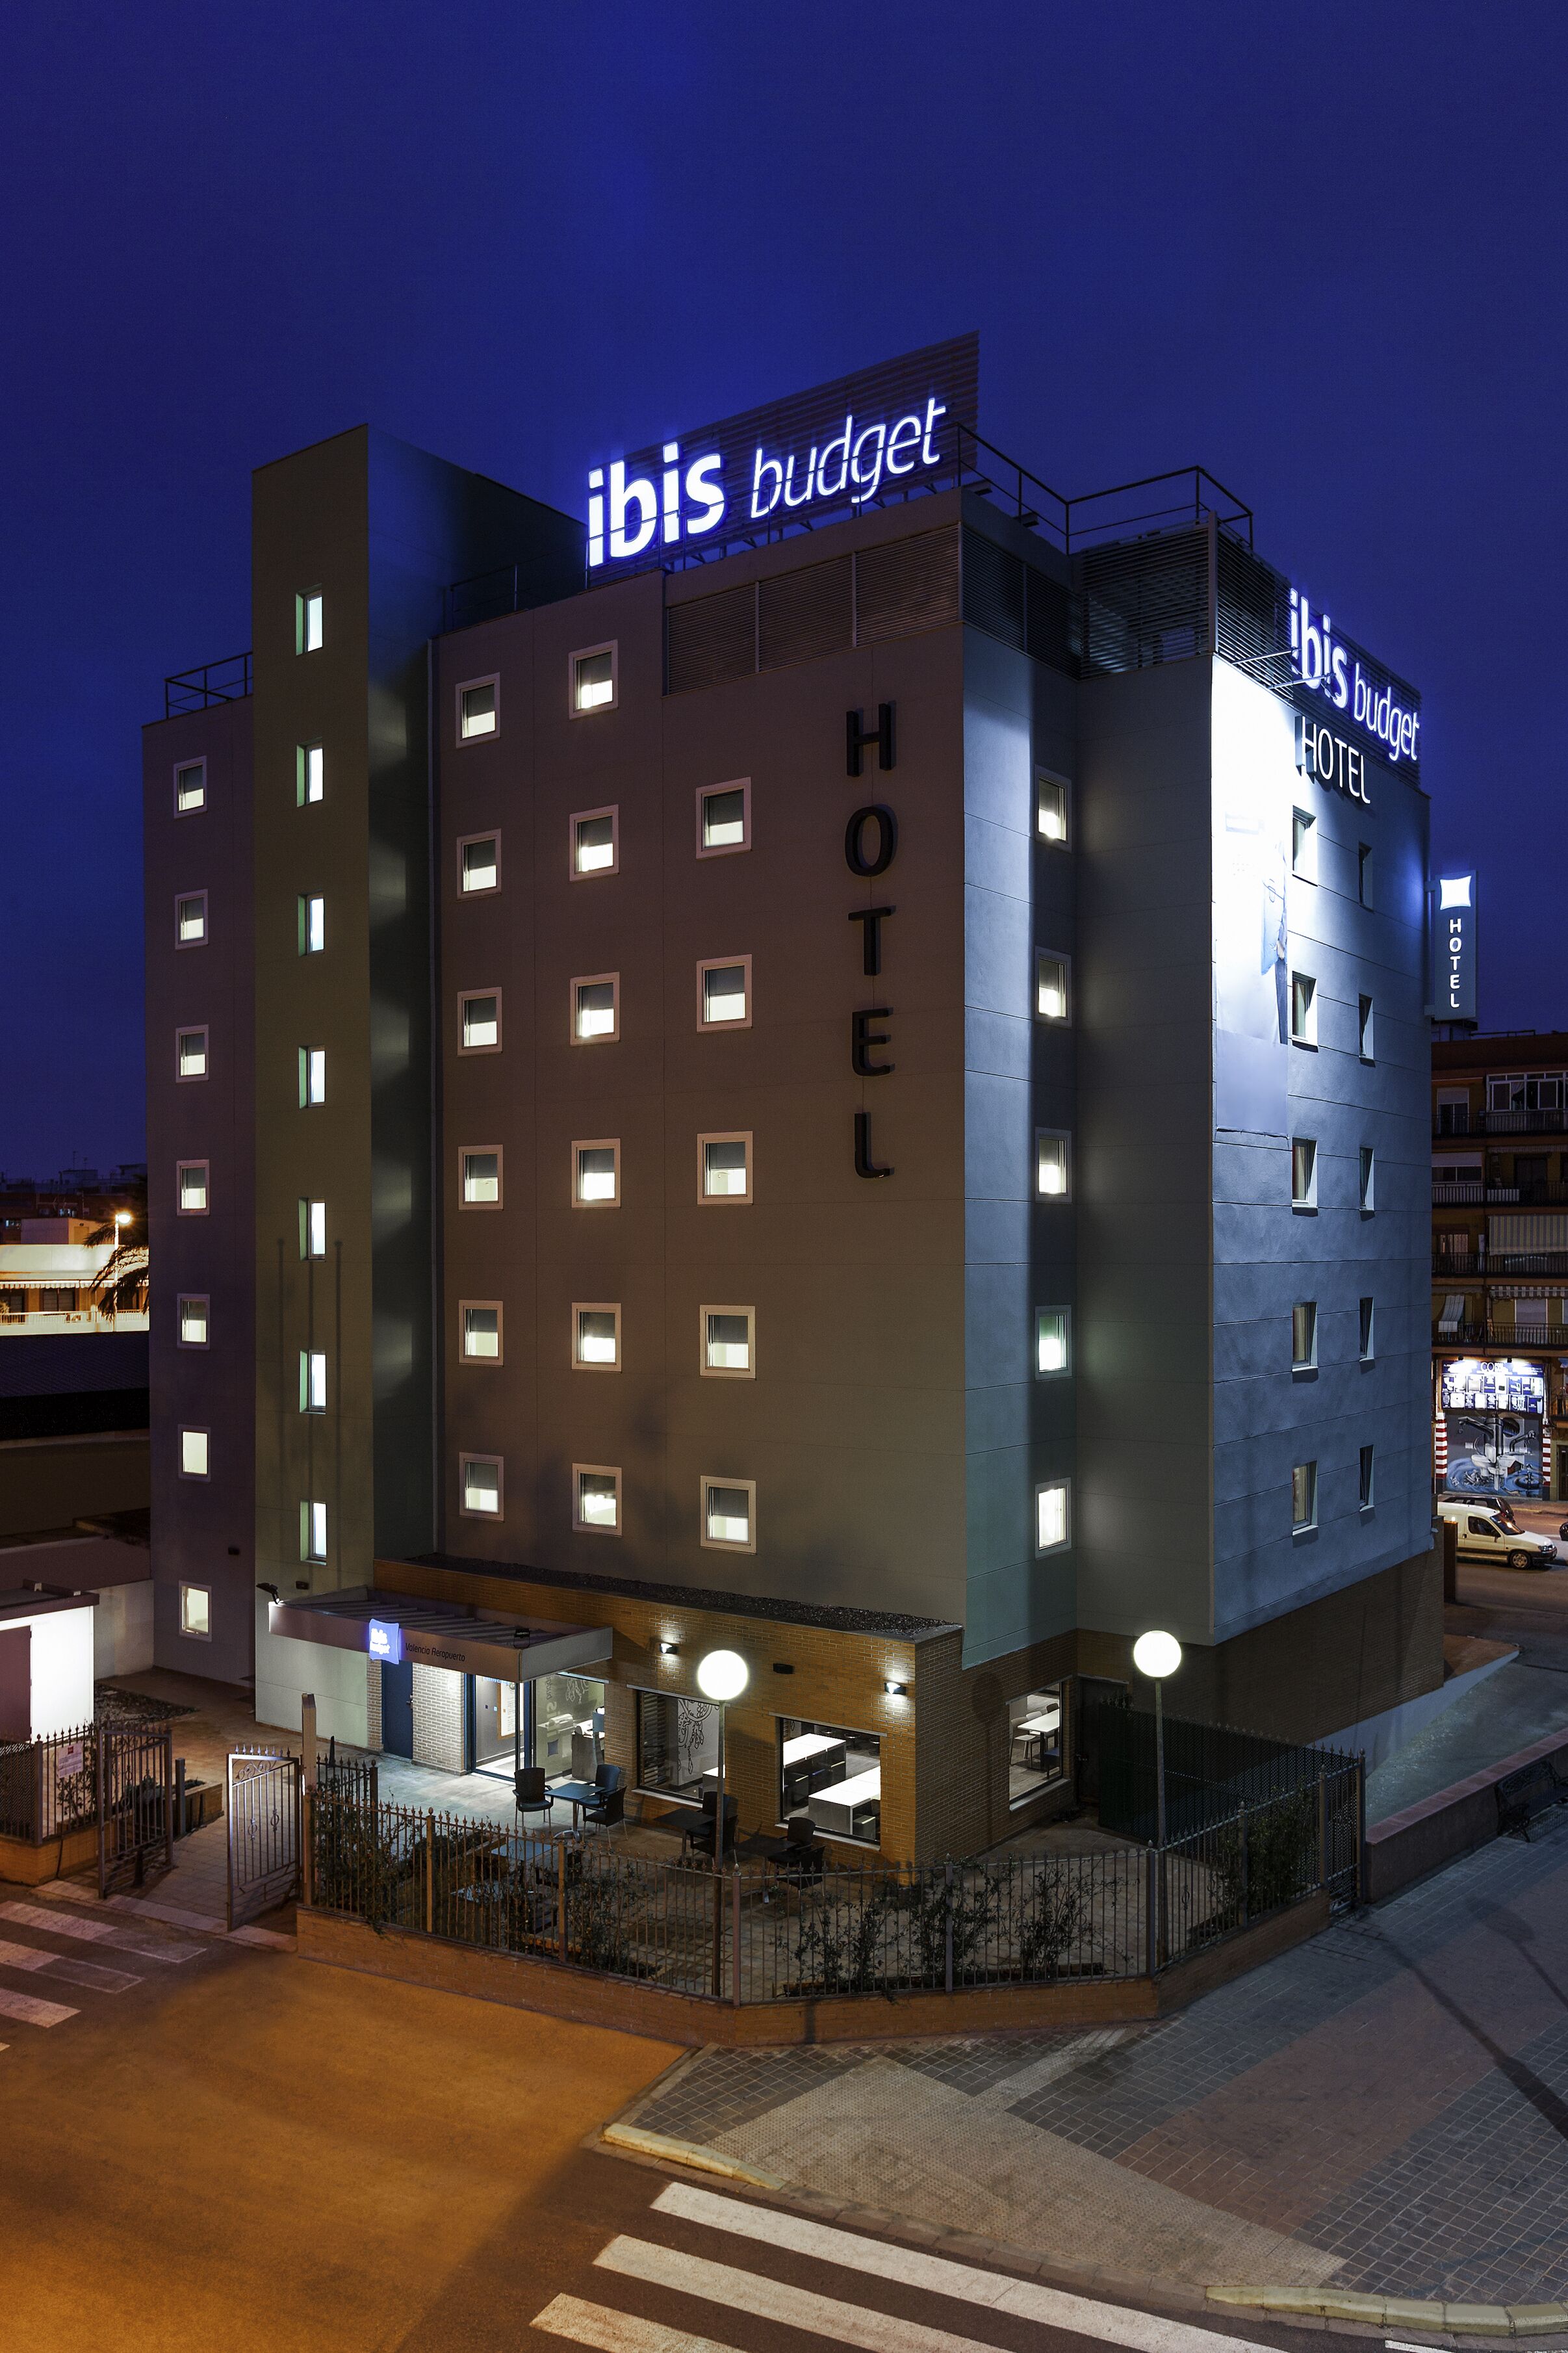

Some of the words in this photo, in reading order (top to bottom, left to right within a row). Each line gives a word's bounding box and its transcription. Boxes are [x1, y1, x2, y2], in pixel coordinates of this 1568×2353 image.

[587, 442, 725, 567] ibis
[751, 397, 946, 519] budget
[1290, 588, 1348, 708] ibis
[1353, 662, 1420, 761] budget
[1300, 715, 1370, 803] HOTEL
[845, 700, 896, 1179] HOTEL
[1449, 918, 1461, 1008] HOTEL
[431, 1647, 466, 1662] Aeropuerto
